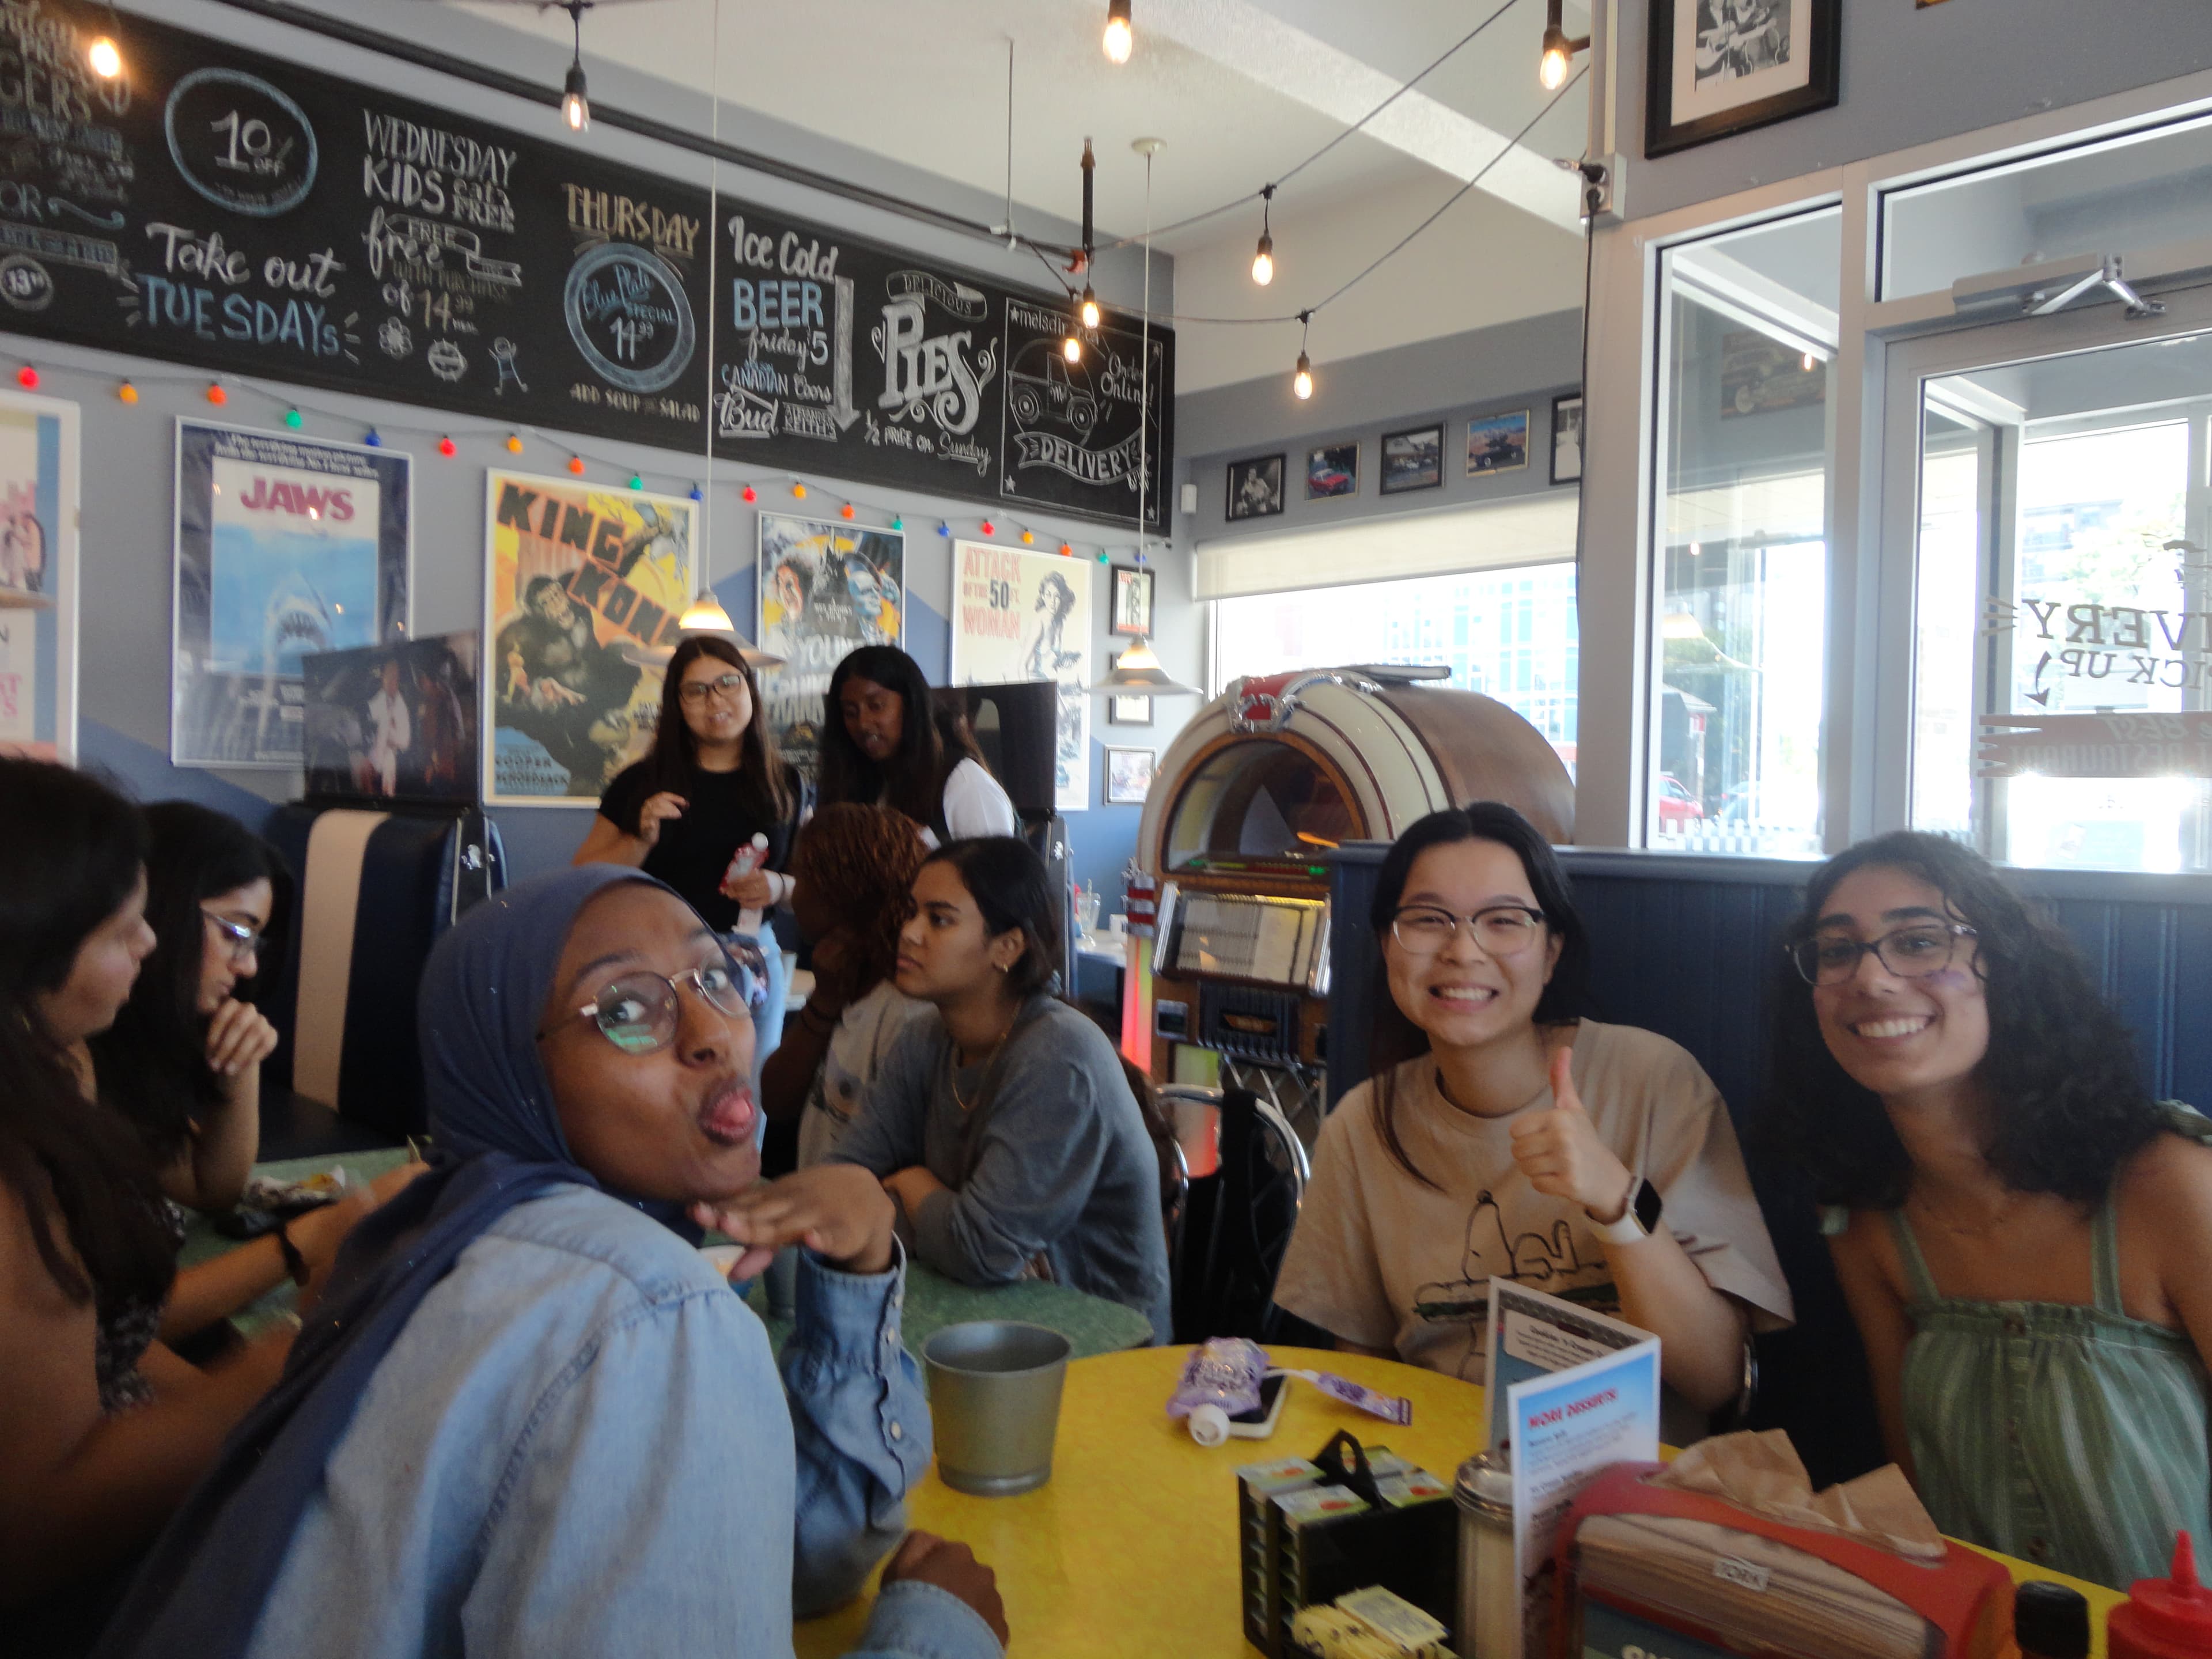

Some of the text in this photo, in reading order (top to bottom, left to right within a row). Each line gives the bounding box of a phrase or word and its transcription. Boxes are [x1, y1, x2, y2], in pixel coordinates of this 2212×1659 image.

[364, 108, 517, 189] WEDNESDAY
[364, 154, 445, 214] KIDS
[560, 183, 700, 255] THURSDAY
[145, 222, 251, 286] Take
[264, 247, 346, 299] out
[728, 215, 839, 285] Ice Cold
[733, 278, 824, 331] BEER
[903, 274, 972, 316] DELICIOUS
[878, 300, 980, 435] PIES
[713, 391, 779, 435] Bud
[937, 431, 992, 478] Sunday
[1040, 436, 1132, 479] DELIVERY
[240, 475, 355, 521] JAWS
[496, 480, 626, 570] KING
[963, 546, 1022, 585] ATTACK
[568, 559, 681, 646] KON
[990, 579, 1010, 610] 50
[963, 603, 1021, 641] WOMAN
[796, 633, 866, 666] YOUN
